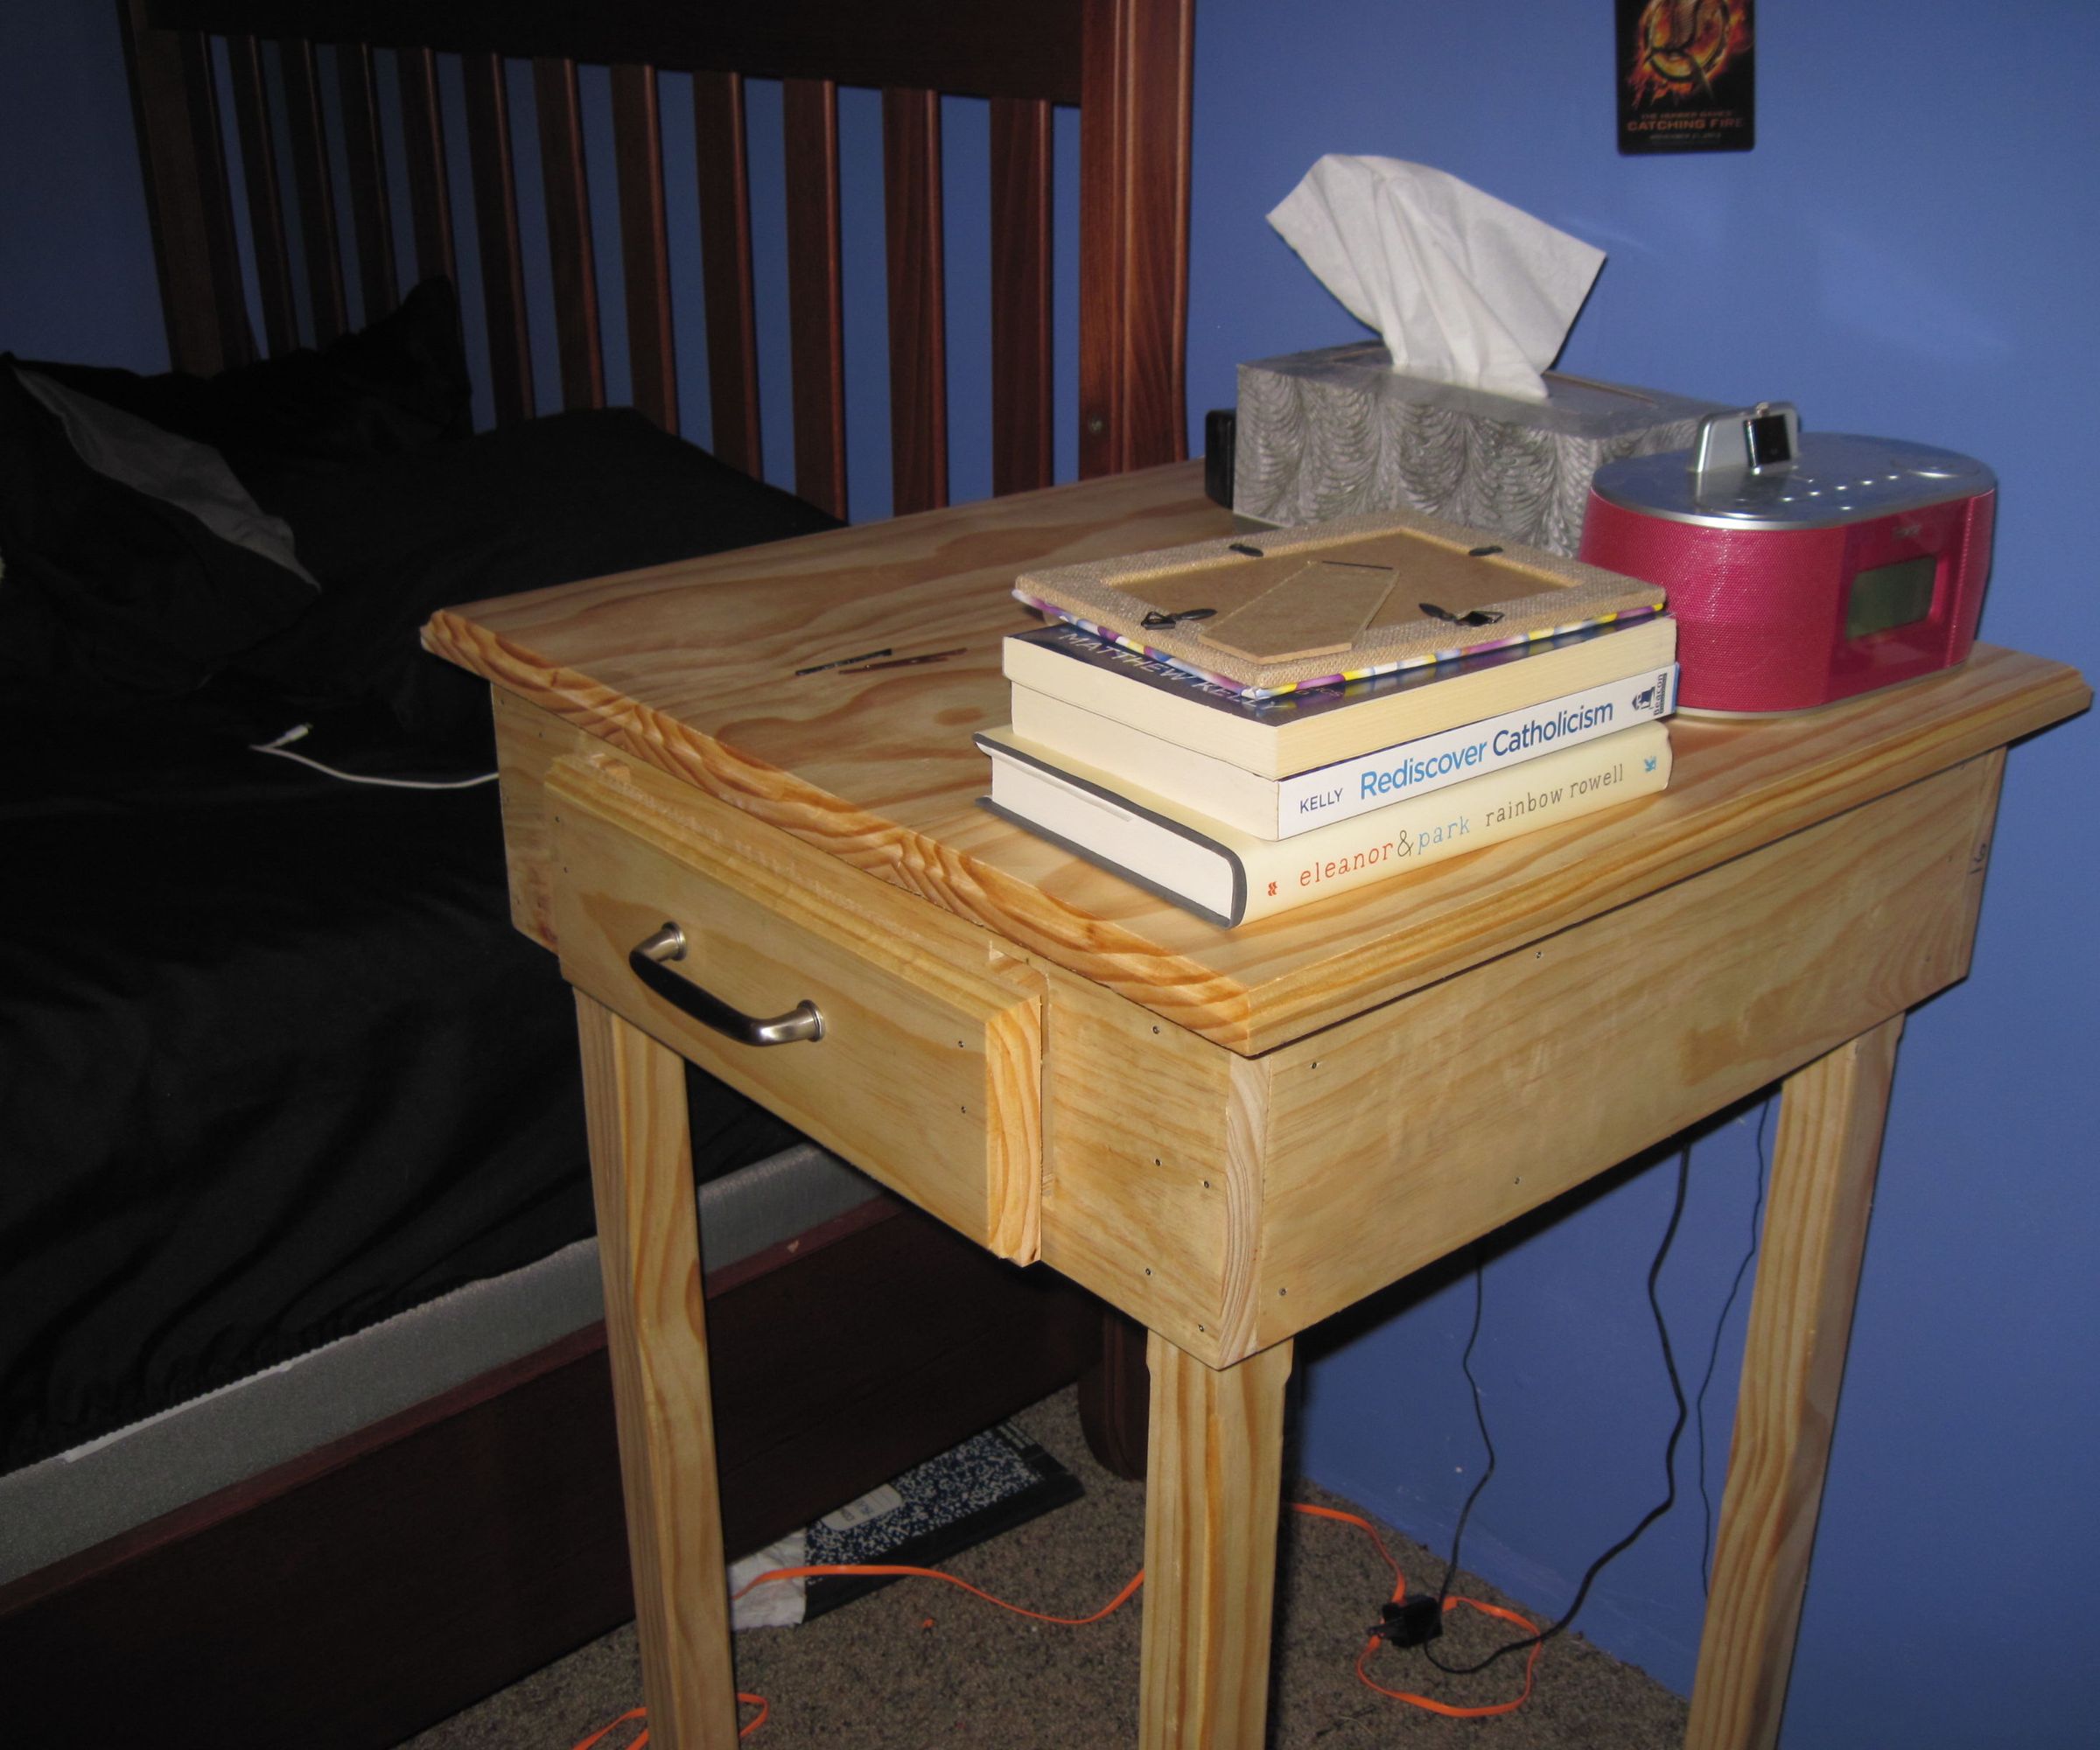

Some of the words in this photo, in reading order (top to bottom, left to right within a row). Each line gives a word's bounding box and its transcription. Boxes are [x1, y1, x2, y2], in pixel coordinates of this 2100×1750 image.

[1628, 119, 1705, 131] CATCHING
[1710, 118, 1743, 129] FIRE
[1058, 633, 1195, 681] MATTHEW
[1299, 788, 1343, 814] KELLY
[1360, 740, 1488, 800] Rediscover
[1492, 702, 1614, 756] Catholicism
[1485, 787, 1564, 828] rainbow
[1569, 763, 1624, 799] rowell
